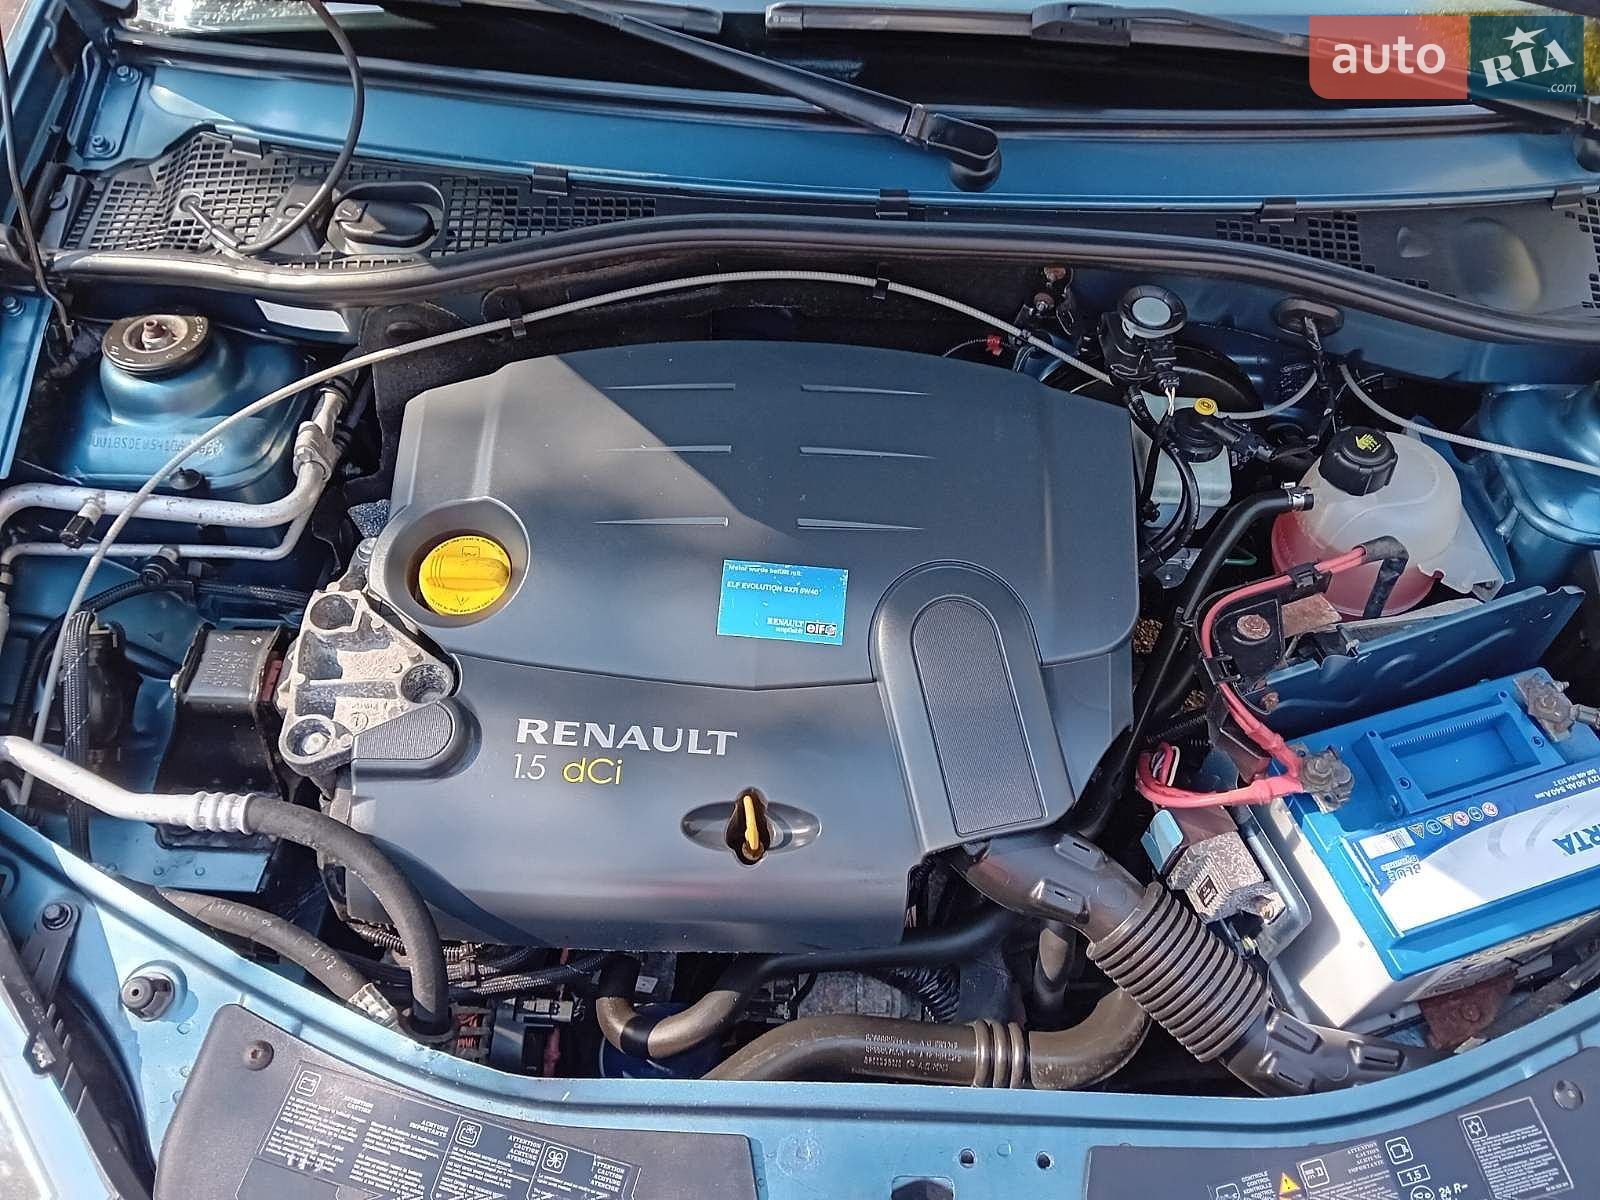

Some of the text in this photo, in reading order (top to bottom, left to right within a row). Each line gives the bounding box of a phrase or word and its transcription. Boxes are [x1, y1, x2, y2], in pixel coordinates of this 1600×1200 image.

[727, 581, 742, 589] ELF
[742, 582, 783, 593] EVOLUTION
[806, 621, 826, 633] elf
[516, 718, 738, 755] RENAULT
[513, 753, 623, 785] 1.5 dCi
[1552, 823, 1600, 857] RTA
[1387, 863, 1421, 881] BLUE
